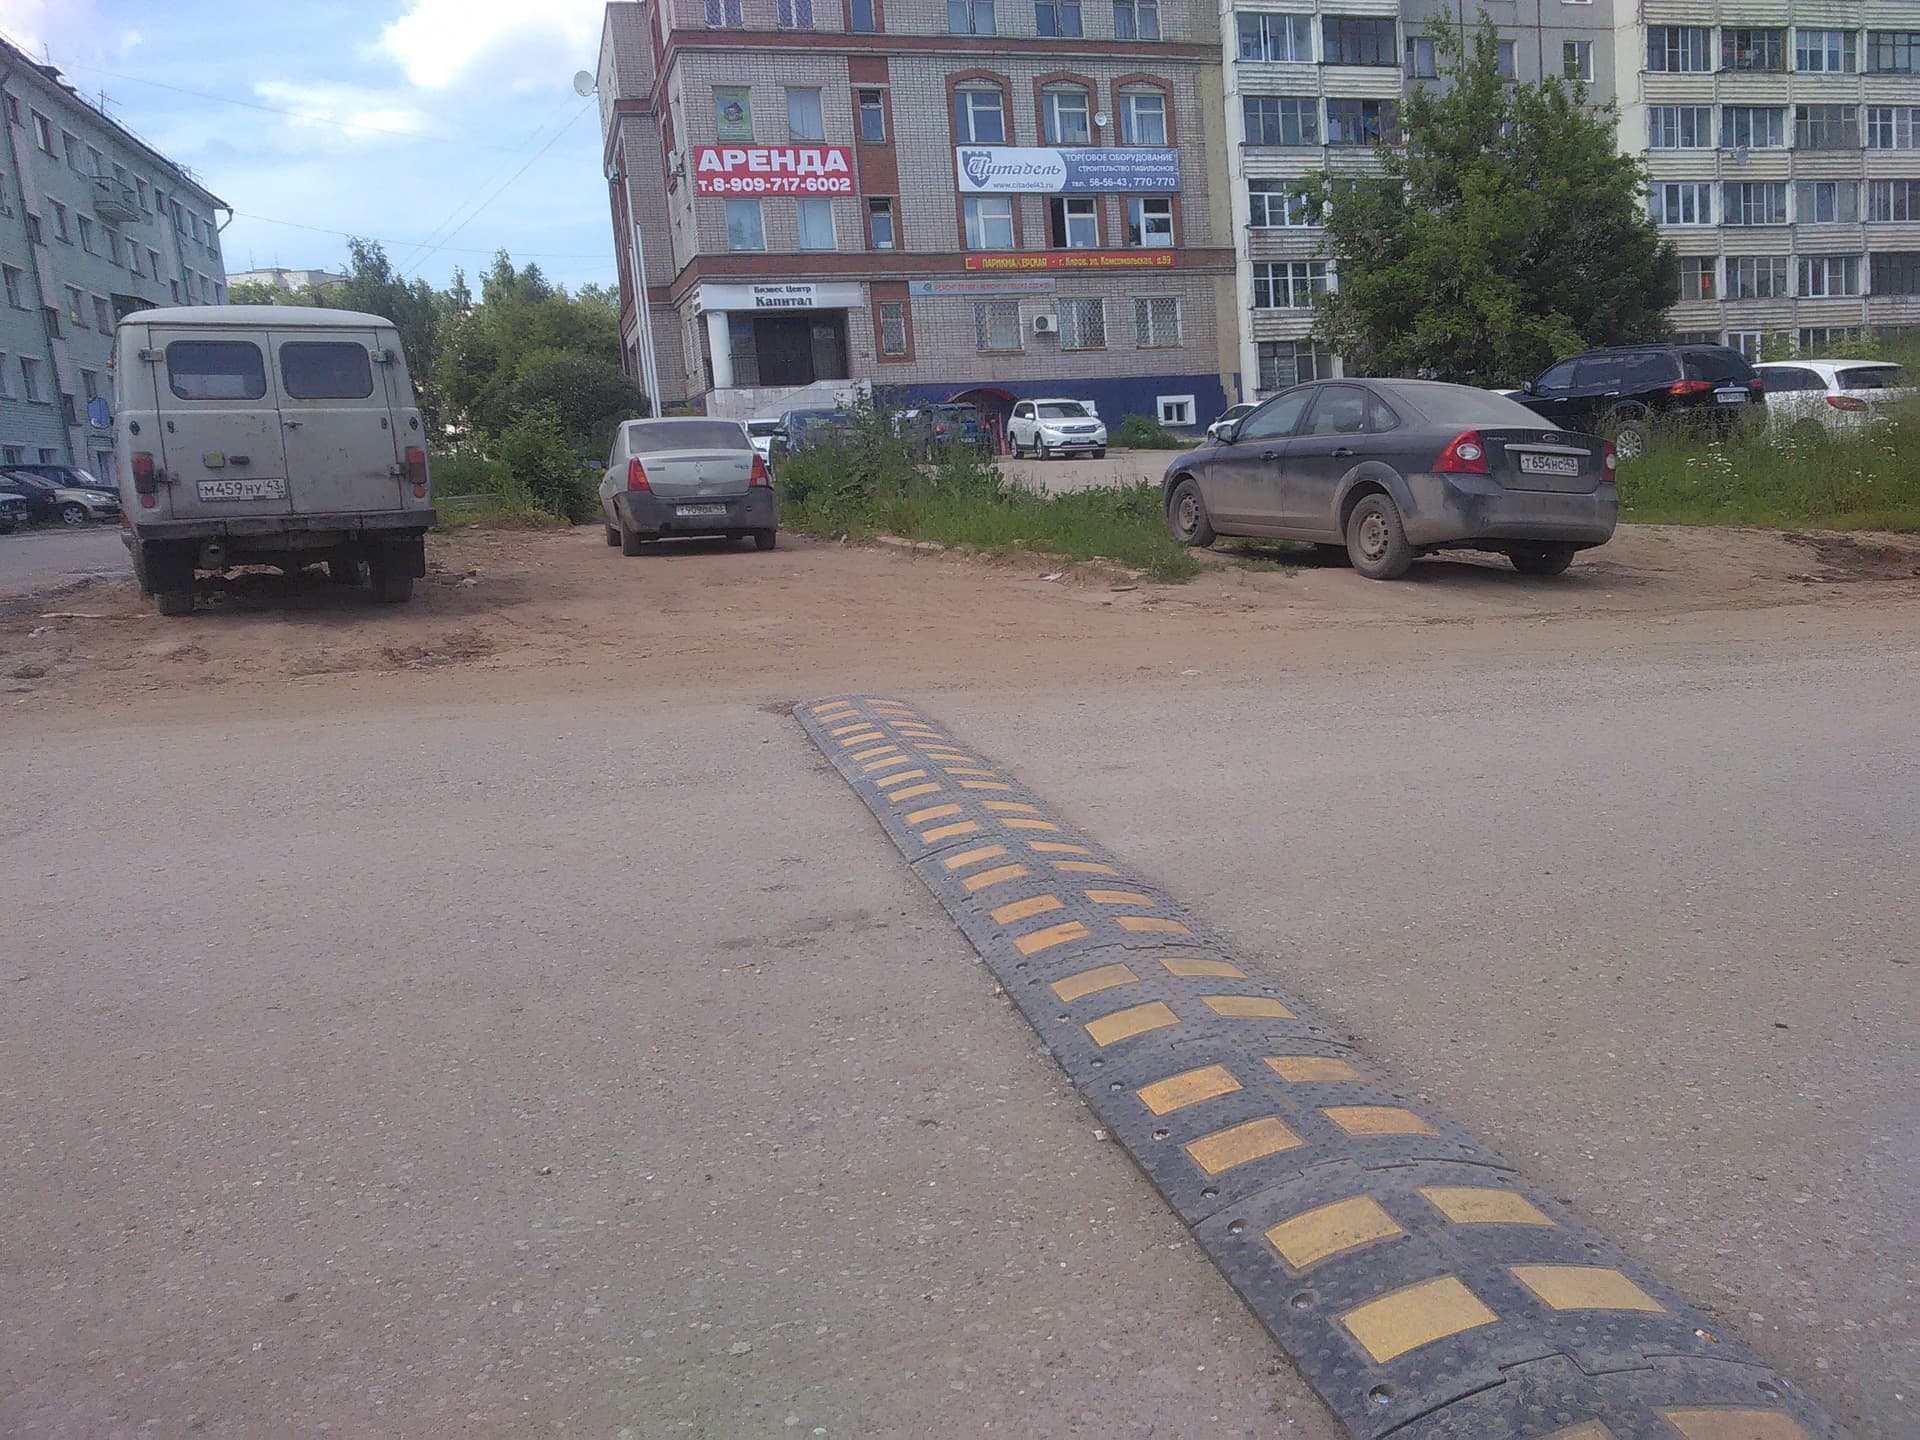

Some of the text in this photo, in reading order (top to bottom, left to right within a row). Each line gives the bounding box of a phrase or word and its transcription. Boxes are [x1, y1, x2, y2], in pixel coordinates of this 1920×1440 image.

[698, 149, 849, 176] АРЕНДА
[1066, 153, 1173, 162] ТОРГОВОЕ ОБОРУДОВАНИЕ
[968, 159, 1061, 180] Цитадель
[993, 181, 1054, 189] www.citadel43.ru
[1133, 177, 1175, 187] 770-770
[754, 286, 811, 295] Бизнес Центр
[756, 296, 812, 307] Капитал
